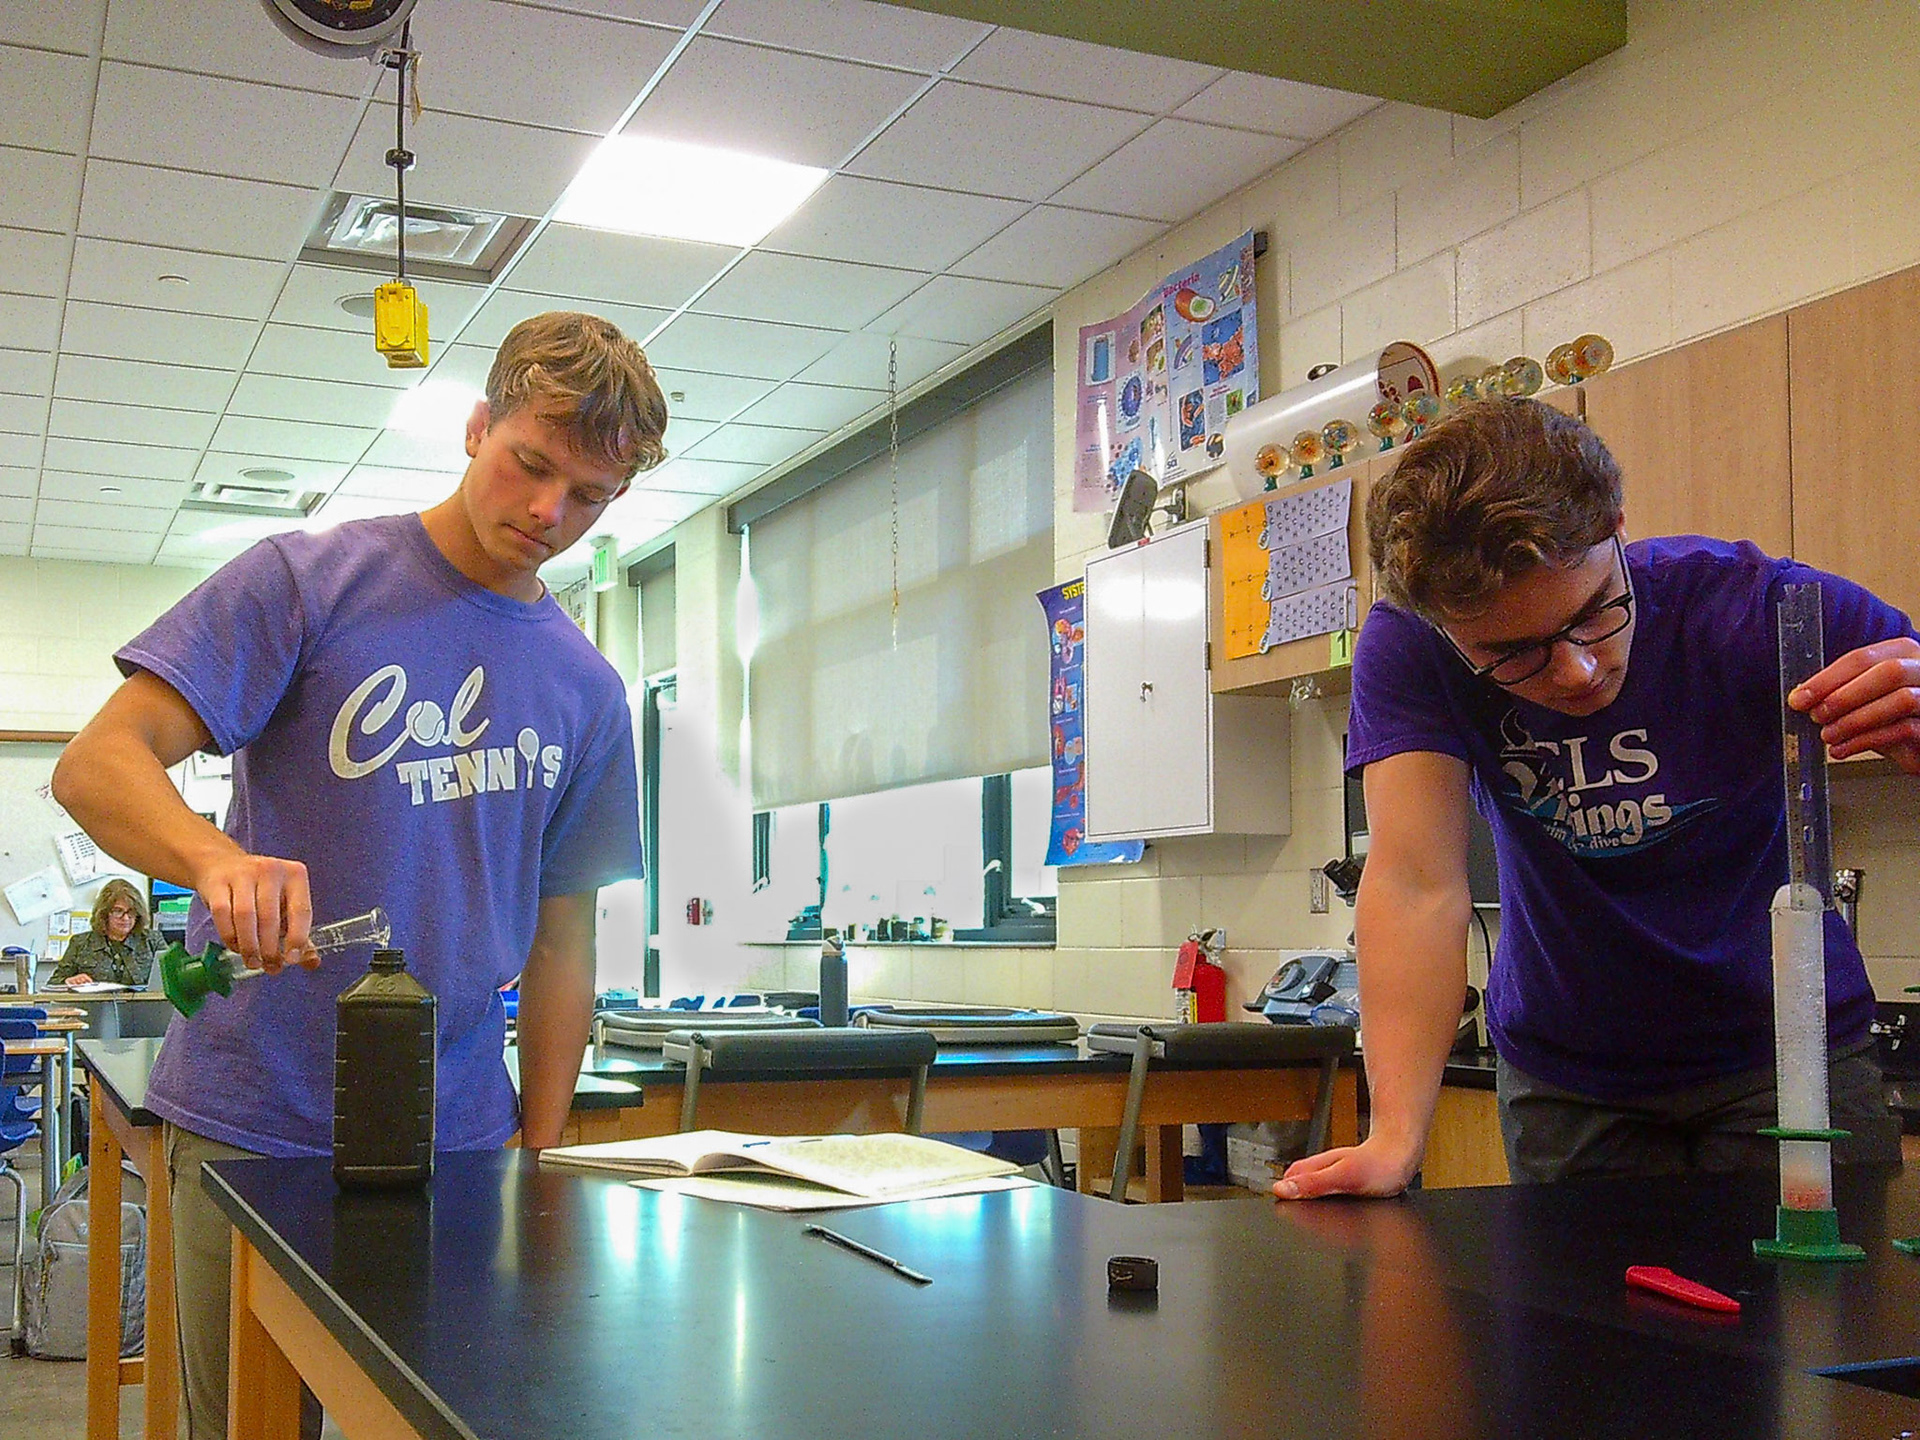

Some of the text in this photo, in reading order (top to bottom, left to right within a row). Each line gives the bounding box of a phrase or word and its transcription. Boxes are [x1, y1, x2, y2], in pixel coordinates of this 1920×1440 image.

[1163, 272, 1200, 298] Bacteria
[1336, 629, 1346, 658] 1
[329, 664, 490, 779] Col
[396, 728, 562, 806] TENNIS
[1590, 836, 1619, 850] dive
